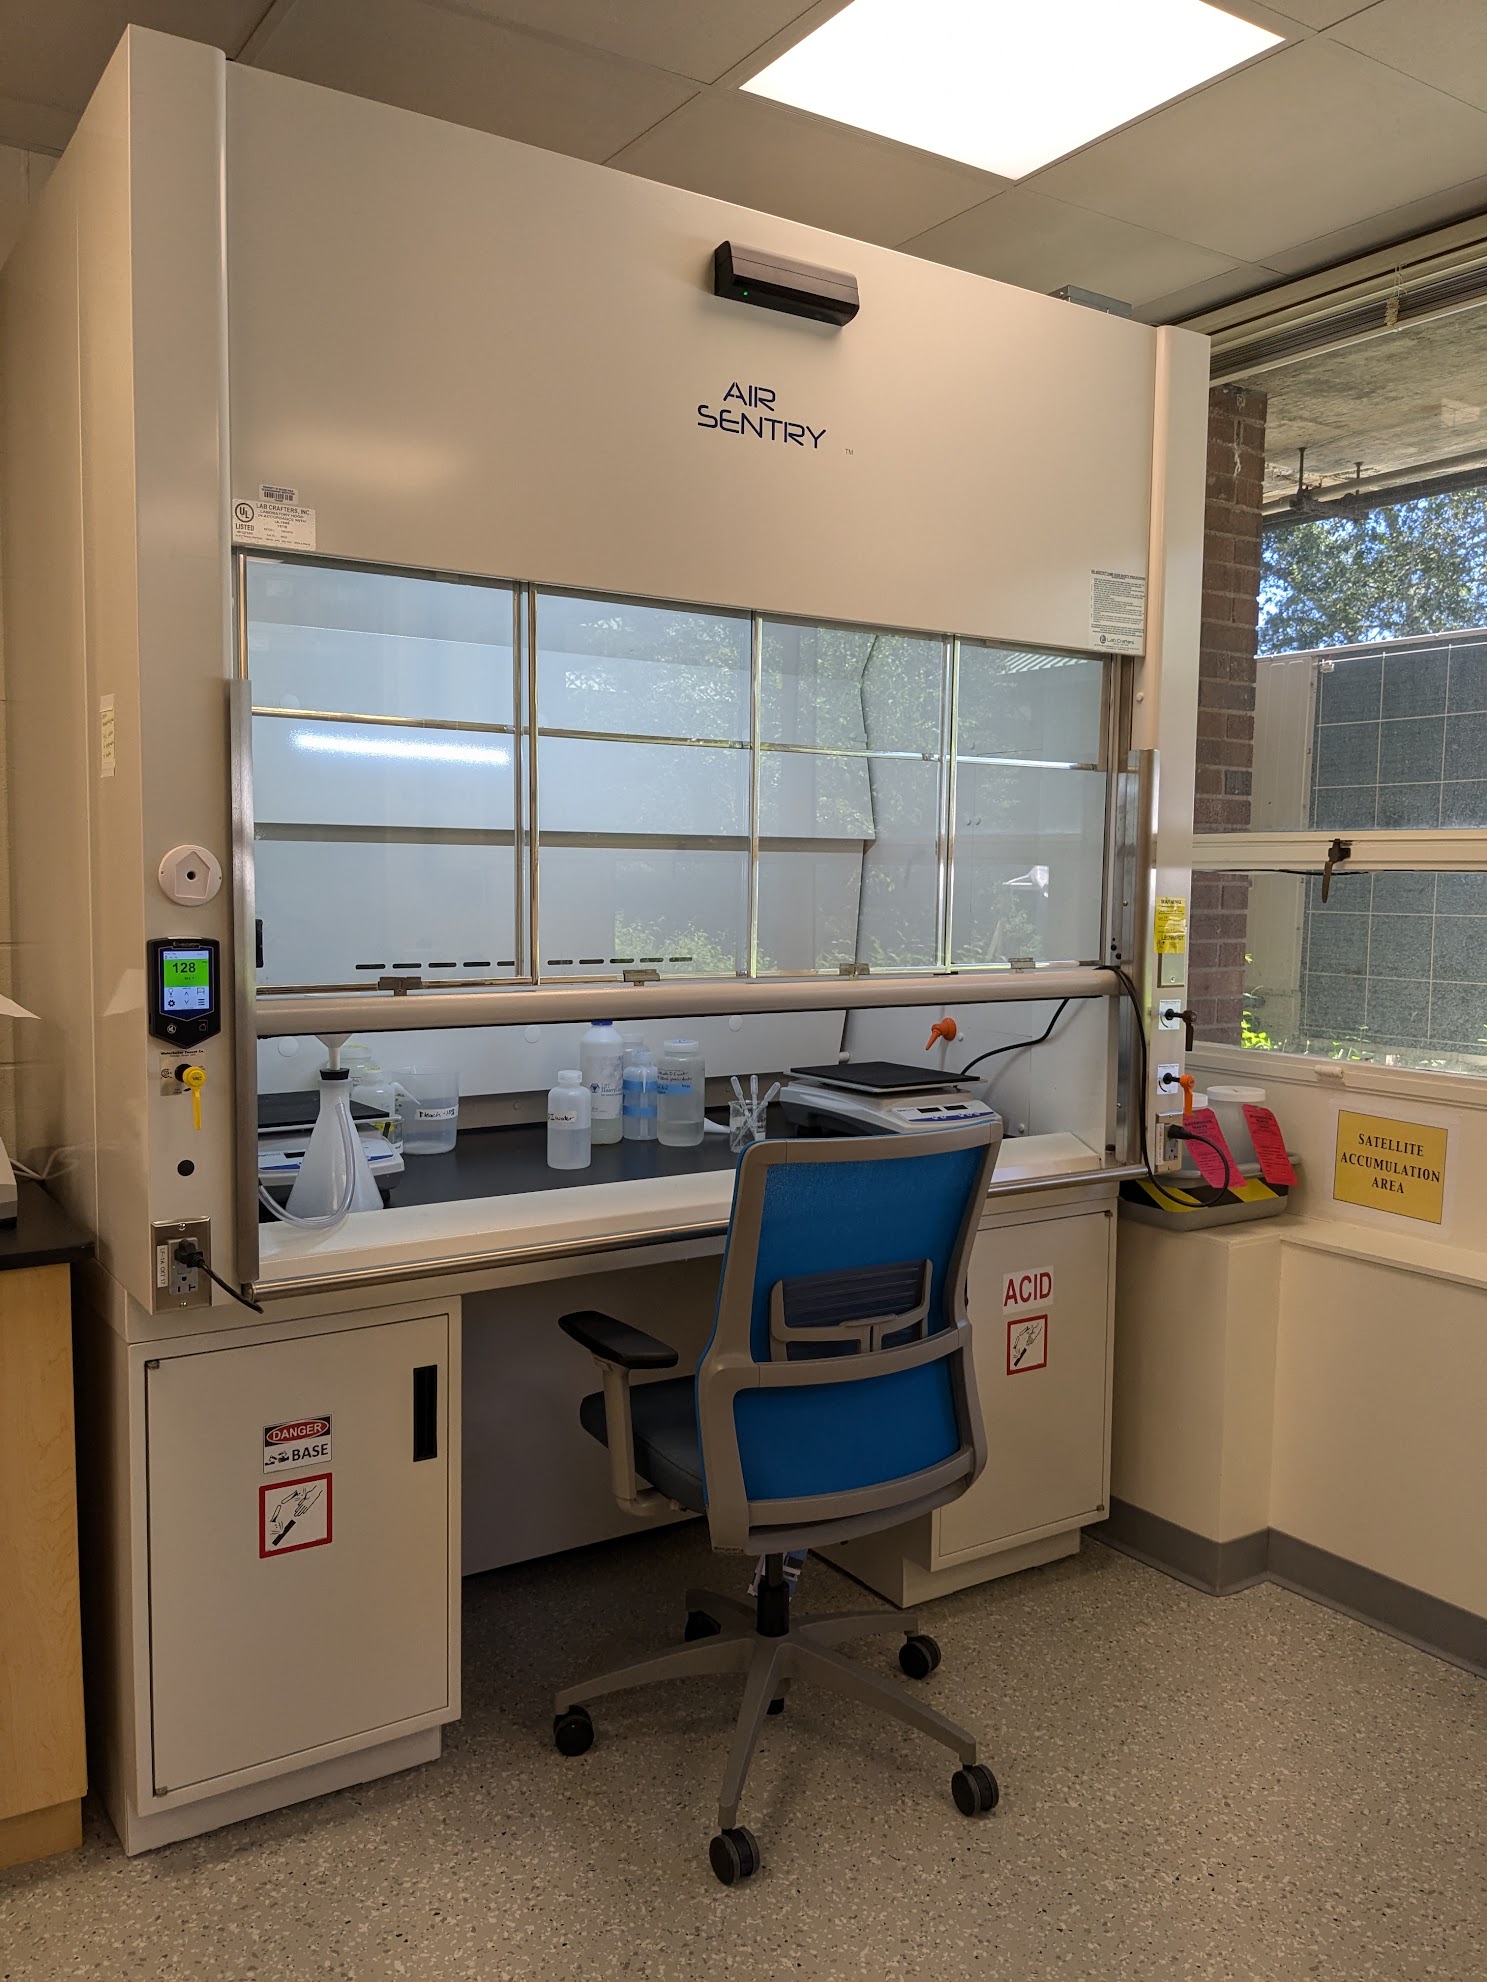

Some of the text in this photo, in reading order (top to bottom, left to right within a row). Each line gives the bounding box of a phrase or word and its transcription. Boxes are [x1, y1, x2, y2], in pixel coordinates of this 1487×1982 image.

[723, 381, 776, 412] AIR
[697, 404, 827, 449] SENTRY
[239, 506, 250, 519] UL
[235, 523, 254, 532] LISTED
[172, 962, 196, 973] 128
[1358, 1133, 1424, 1157] SATELLITE
[1340, 1152, 1441, 1183] ACCUMULATION
[1371, 1176, 1405, 1194] AREA
[1003, 1271, 1052, 1307] ACID
[272, 1422, 323, 1441] DANGER
[292, 1443, 329, 1461] BASE
